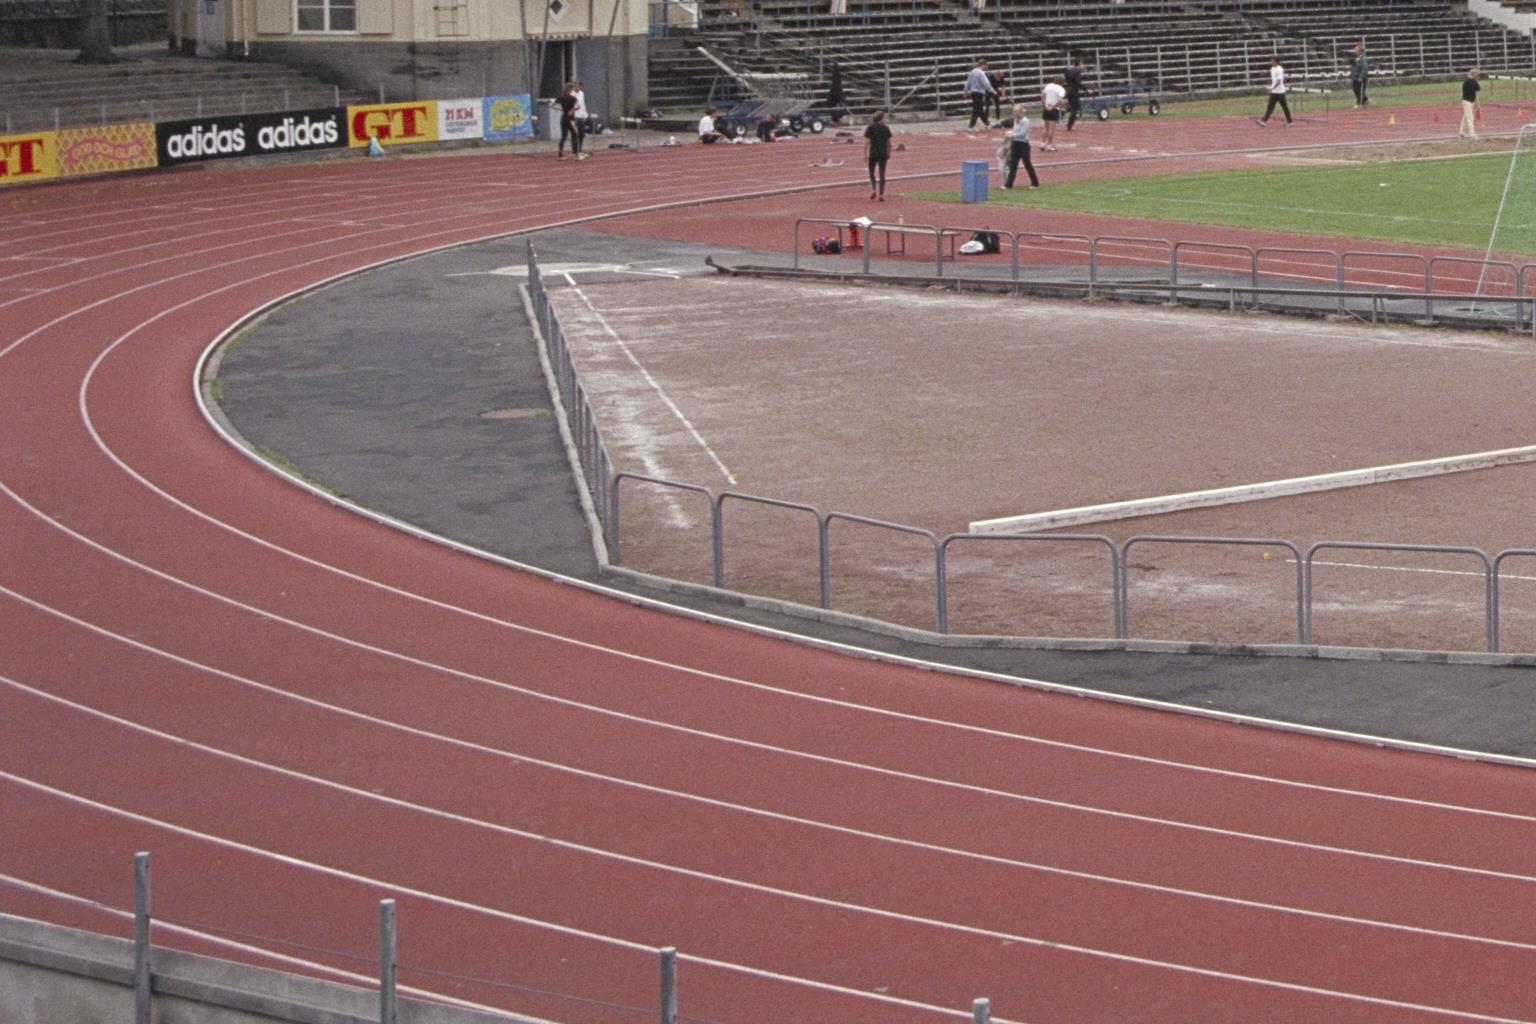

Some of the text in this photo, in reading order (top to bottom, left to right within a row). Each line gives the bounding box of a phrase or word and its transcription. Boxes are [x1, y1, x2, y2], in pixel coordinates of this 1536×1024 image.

[167, 116, 339, 158] adidas adidas
[352, 106, 428, 142] GT
[0, 138, 44, 177] T
